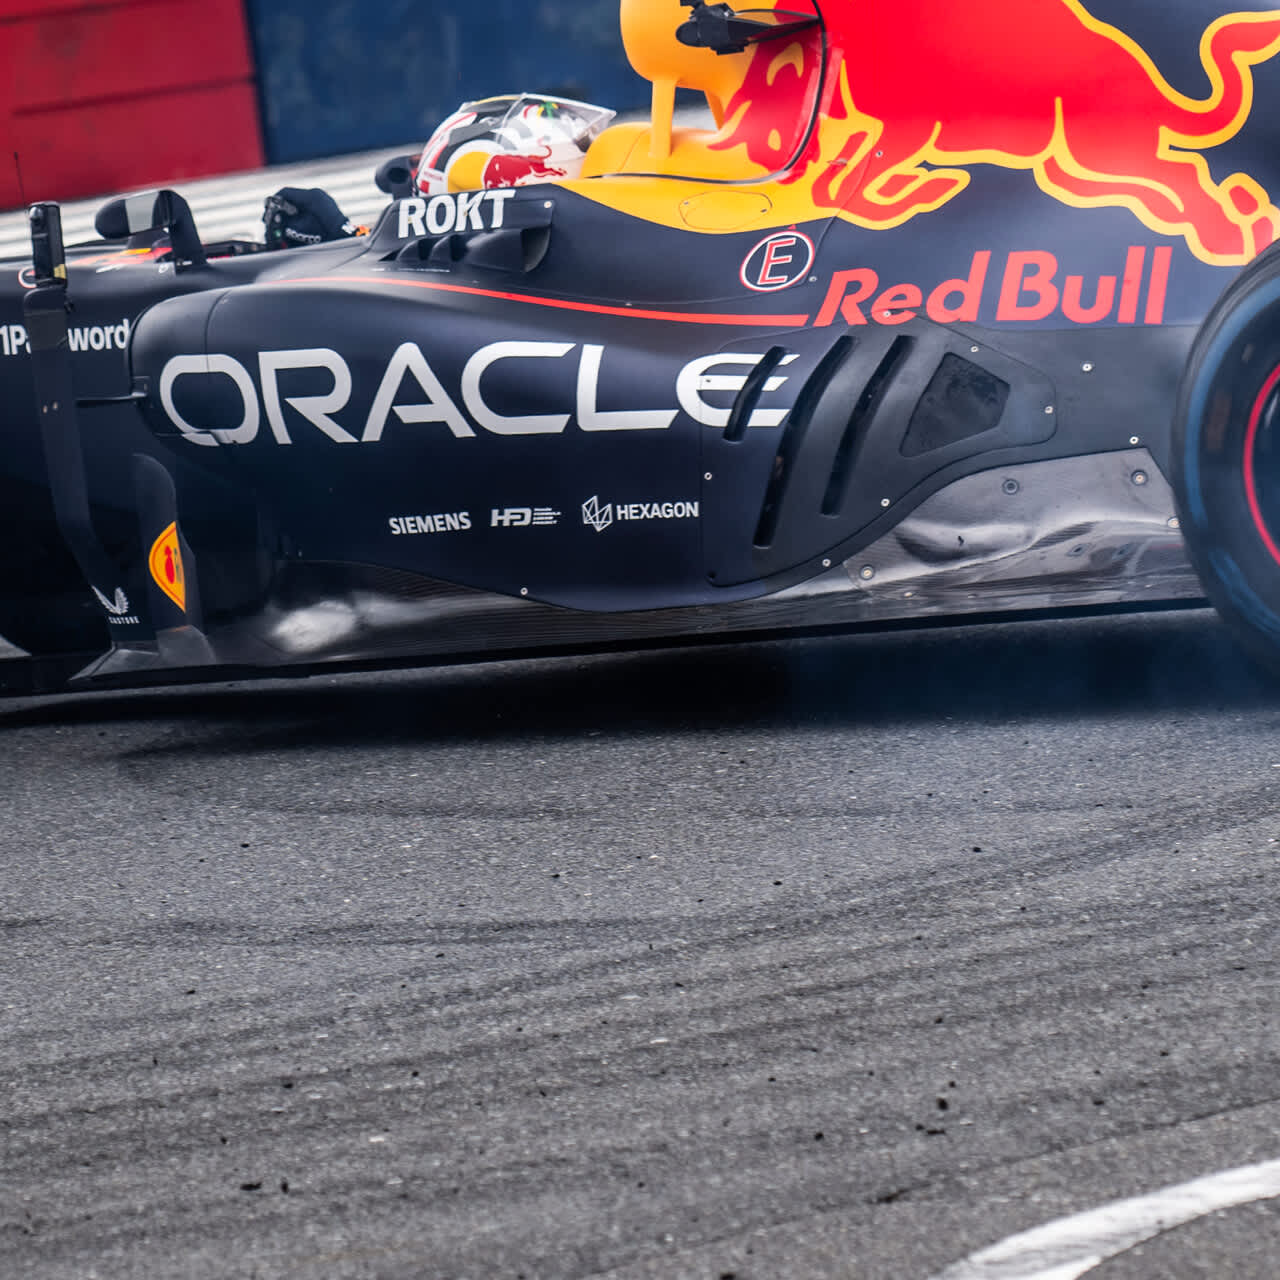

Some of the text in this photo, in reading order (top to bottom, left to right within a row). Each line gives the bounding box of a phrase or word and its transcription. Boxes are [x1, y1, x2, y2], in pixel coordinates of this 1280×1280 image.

[397, 189, 516, 239] ROKT
[757, 237, 796, 285] E
[813, 245, 1173, 328] Red Bull
[159, 341, 800, 447] ORACLE
[388, 511, 471, 535] SIEMENS
[616, 501, 699, 521] HEXAGON
